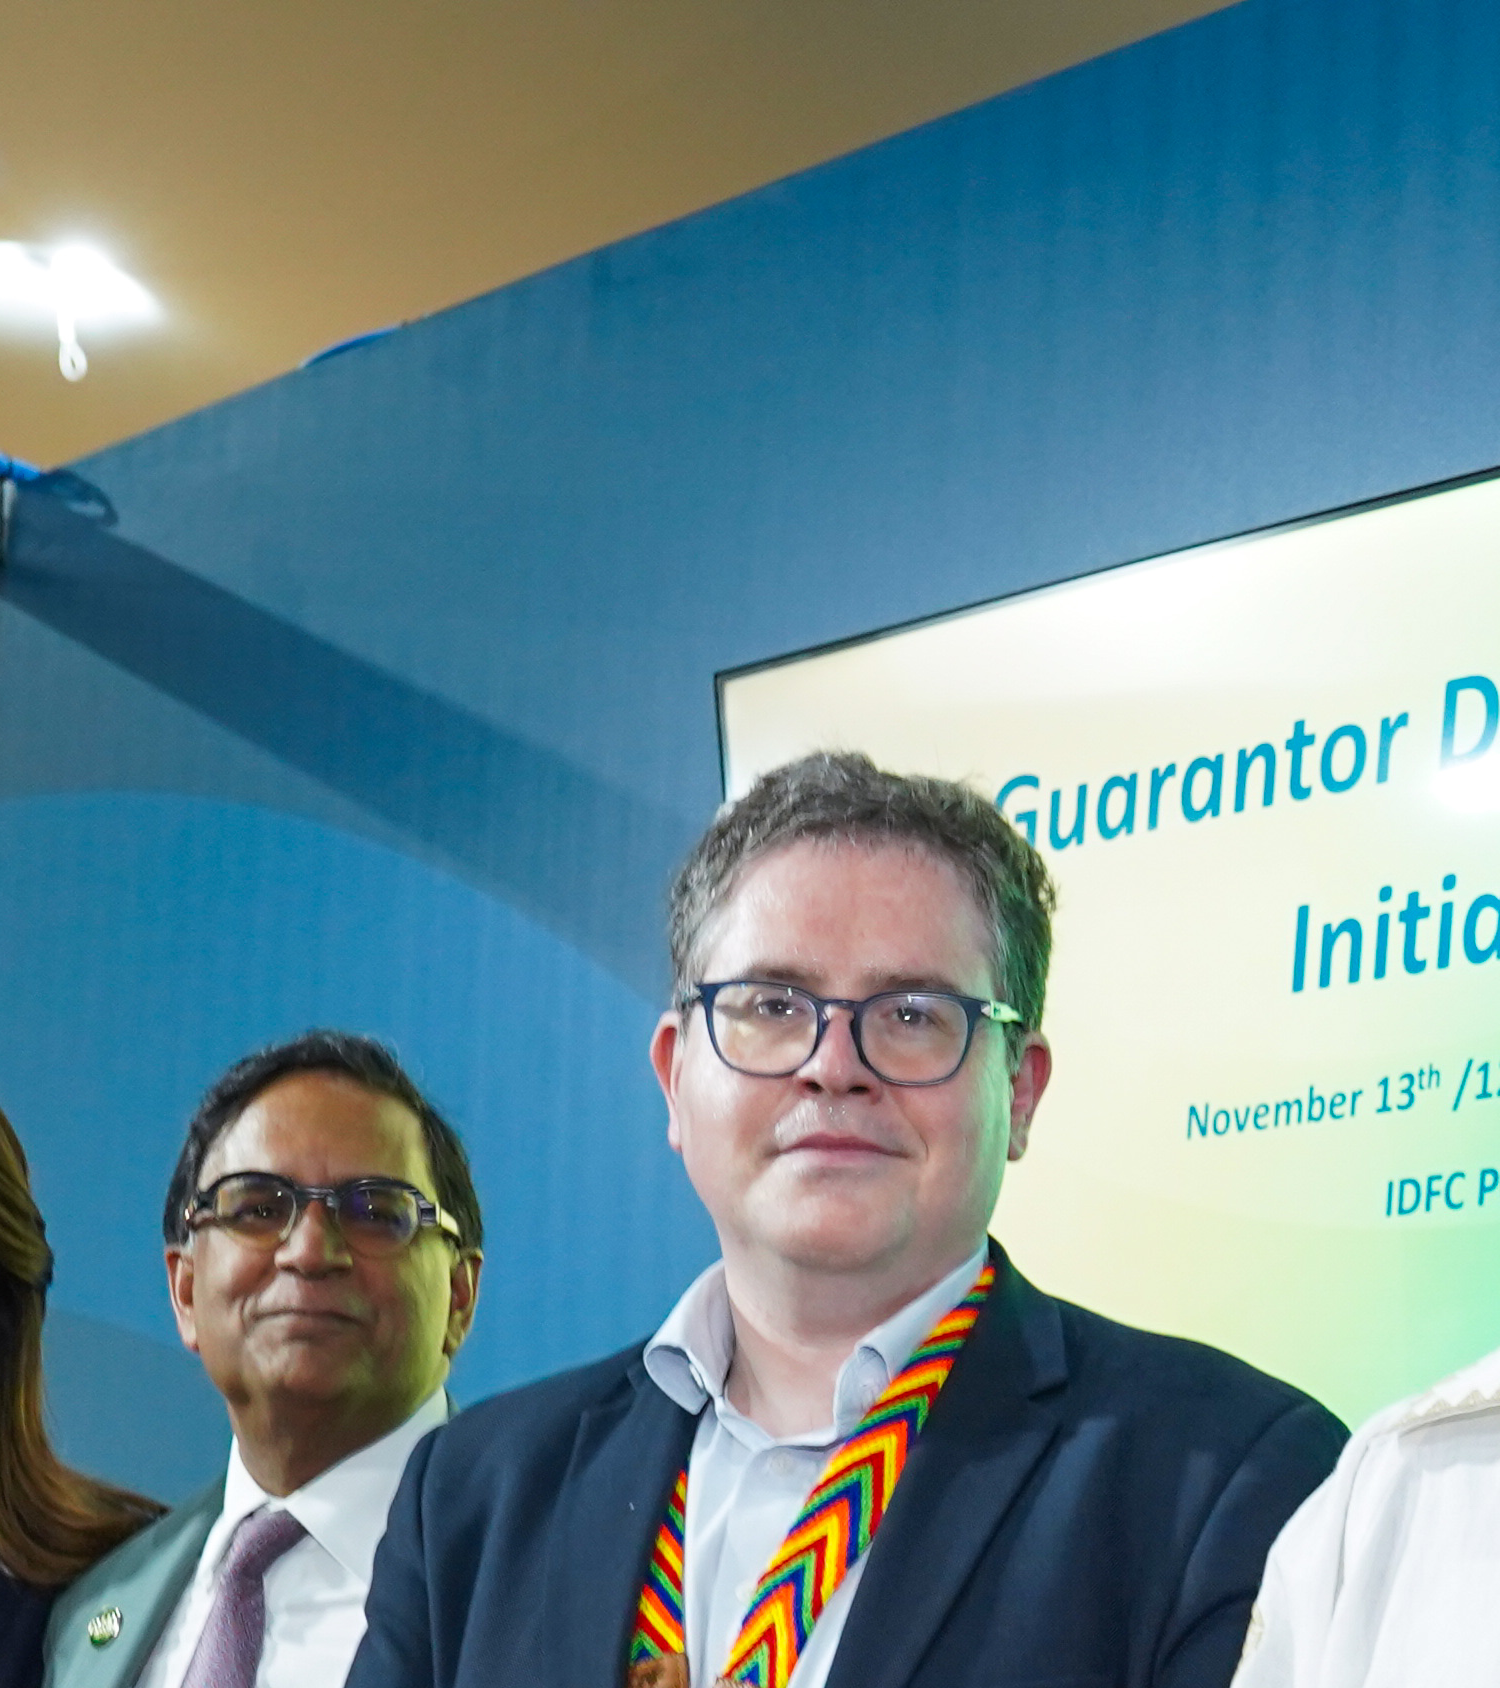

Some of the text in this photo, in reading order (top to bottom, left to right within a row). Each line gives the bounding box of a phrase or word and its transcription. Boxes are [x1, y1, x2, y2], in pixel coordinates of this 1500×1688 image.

[995, 711, 1409, 851] Guarantor
[1187, 1085, 1364, 1140] November
[1386, 1171, 1466, 1217] IDFC
